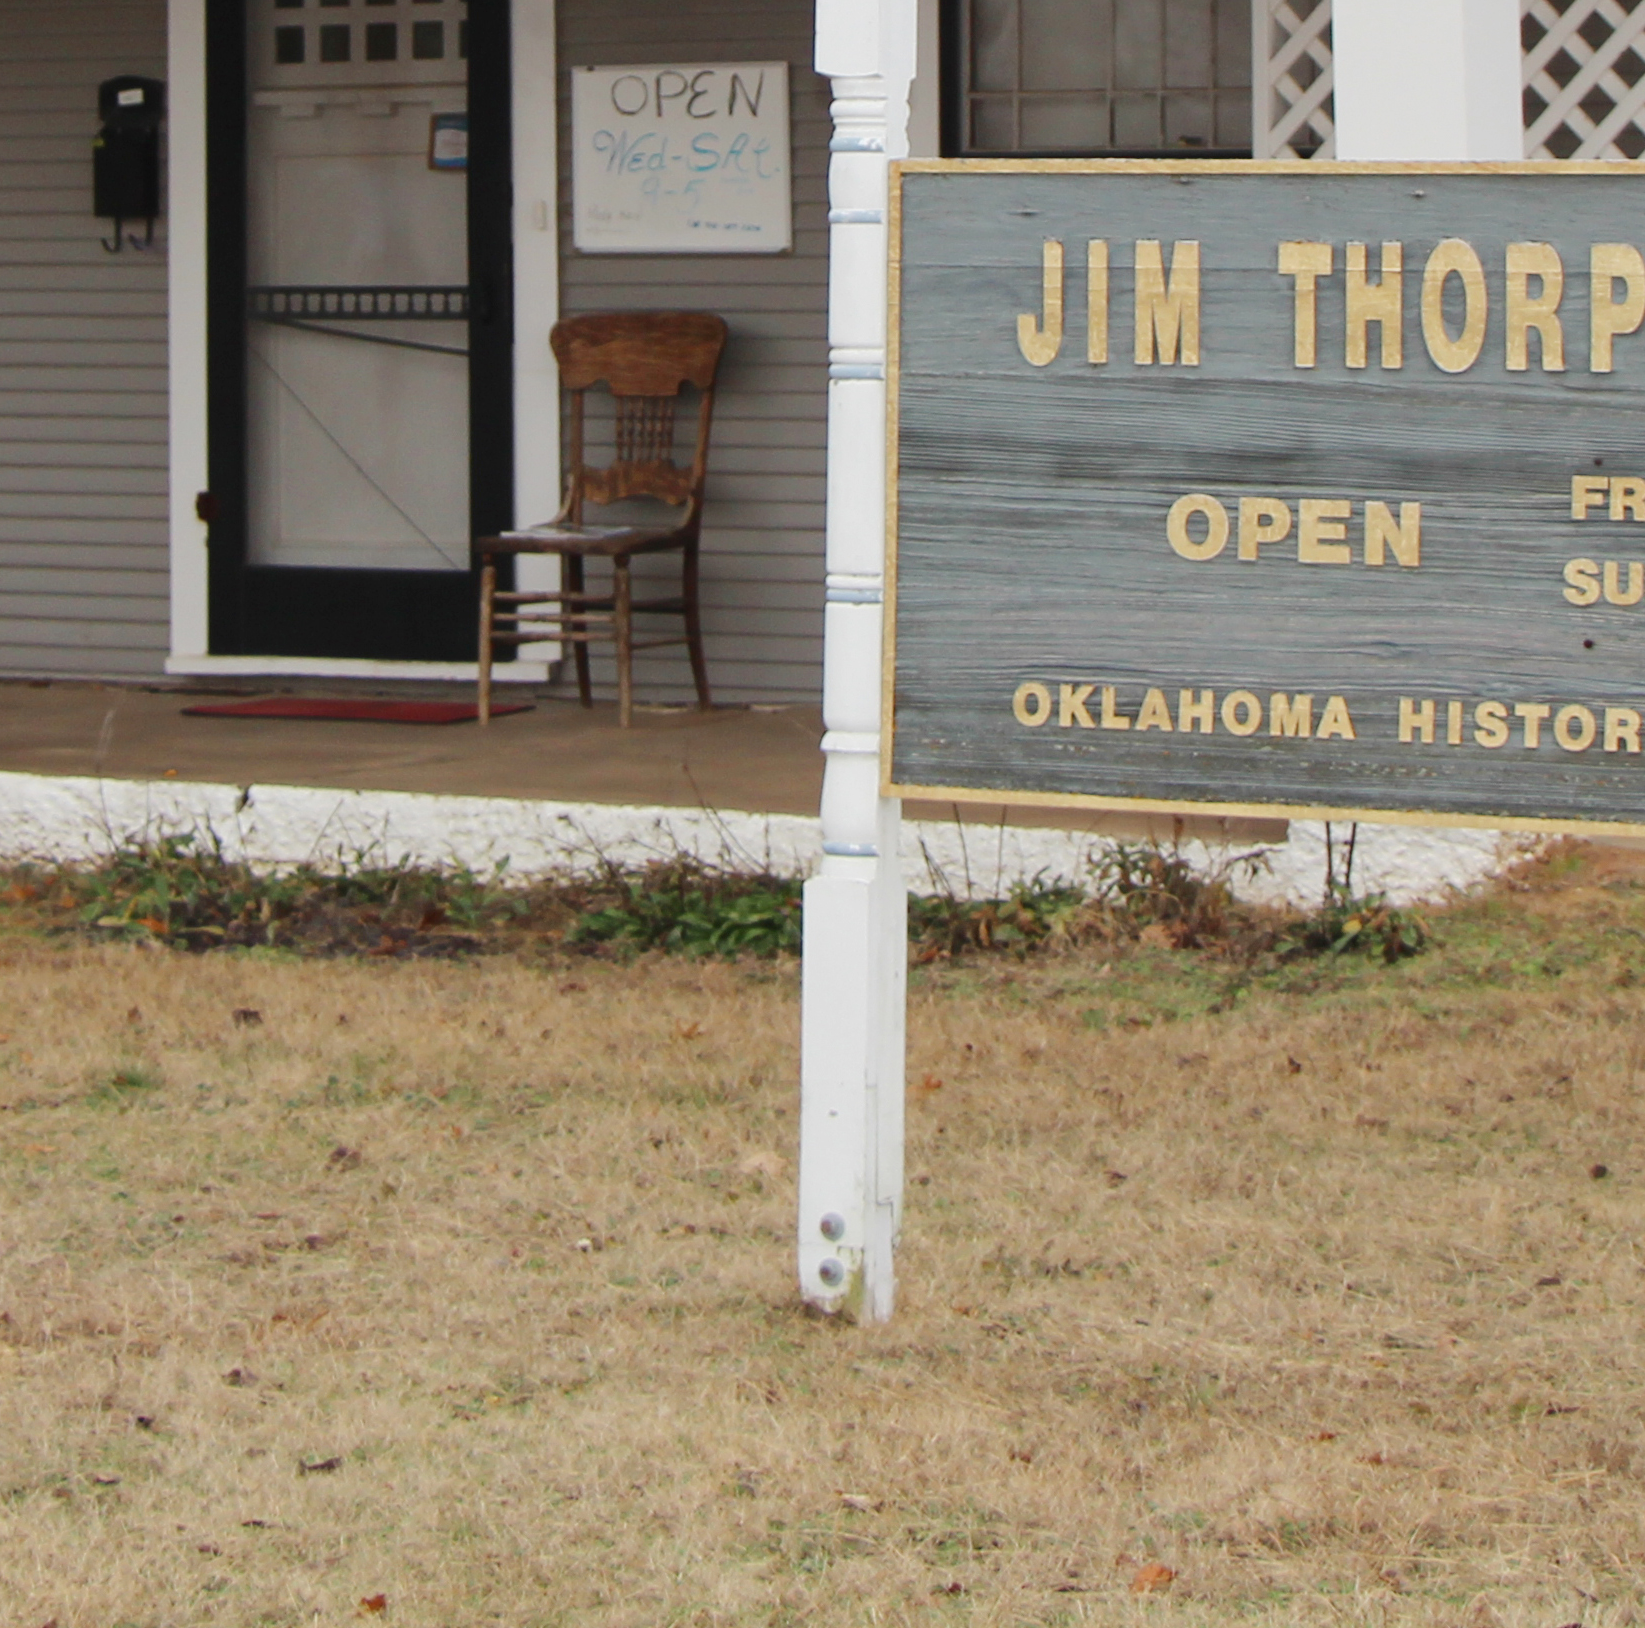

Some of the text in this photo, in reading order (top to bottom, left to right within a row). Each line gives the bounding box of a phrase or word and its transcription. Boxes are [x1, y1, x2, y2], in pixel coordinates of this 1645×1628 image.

[612, 70, 764, 118] OPEN
[1015, 239, 1202, 367] JIM
[1167, 494, 1423, 568] OPEN
[1011, 681, 1358, 742] OKLAHOMA
